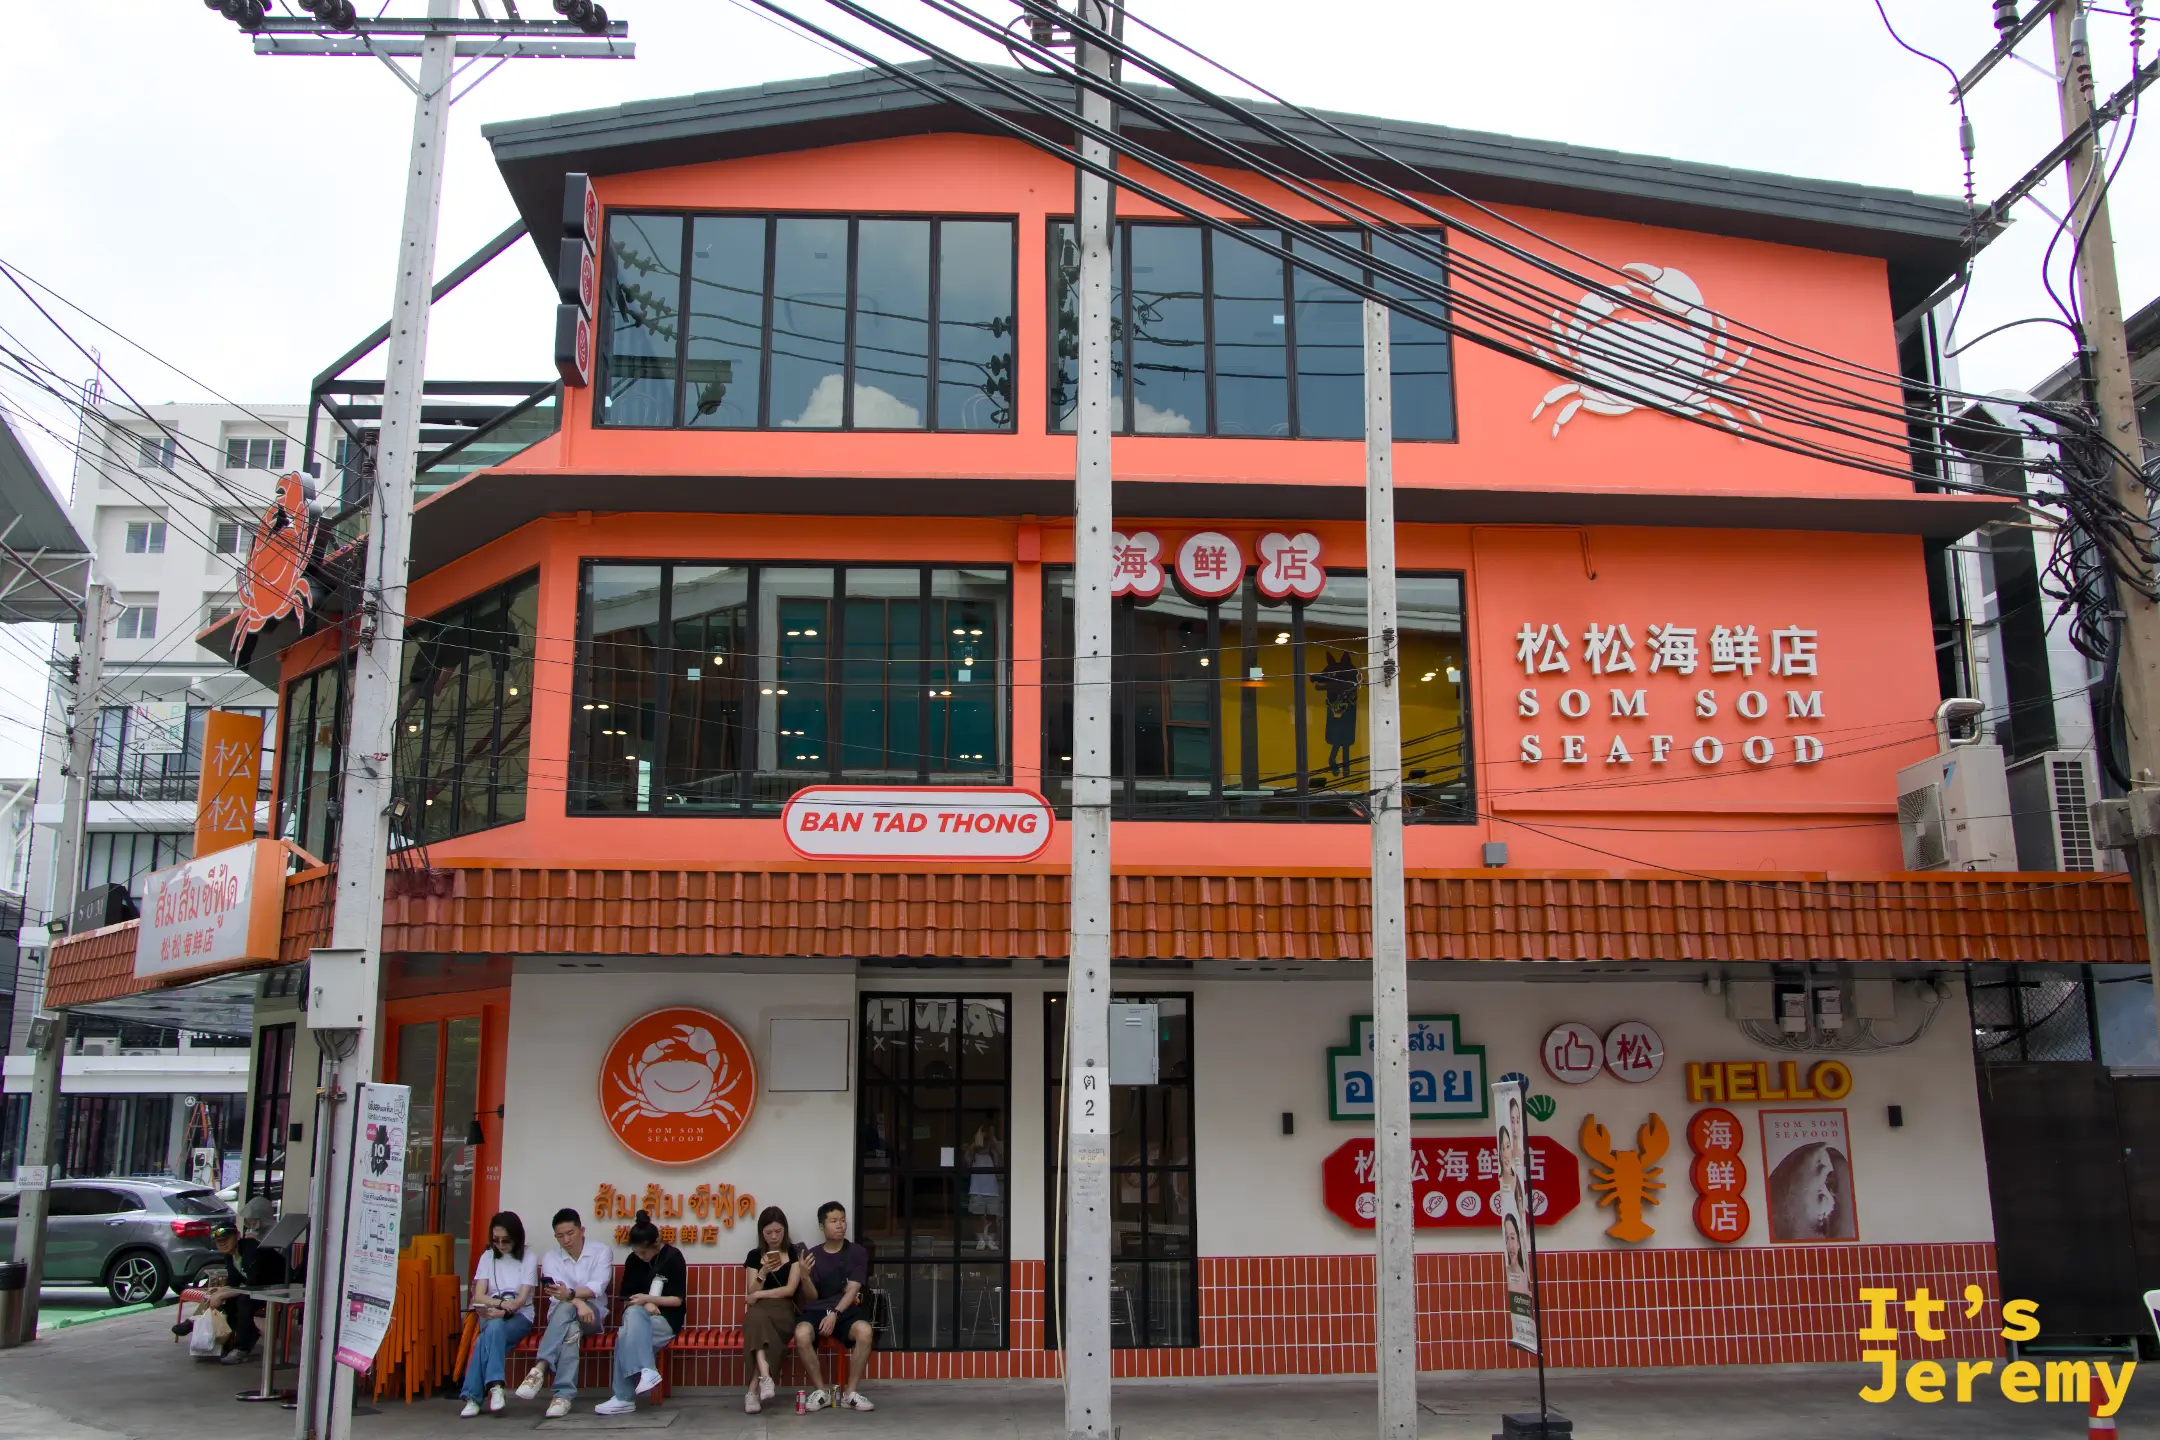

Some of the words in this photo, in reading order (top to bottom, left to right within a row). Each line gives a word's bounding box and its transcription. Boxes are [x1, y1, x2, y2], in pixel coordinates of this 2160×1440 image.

[1112, 544, 1308, 581] 海鲜店
[1516, 622, 1818, 676] 松松海鲜店
[1518, 688, 1649, 718] SOM
[1696, 689, 1825, 719] SOM
[1519, 734, 1825, 765] SEAFOOD
[207, 738, 253, 833] 松松
[800, 812, 864, 832] BAN
[873, 812, 928, 833] TAD
[937, 813, 1038, 834] THONG
[1616, 1033, 1653, 1071] 松
[1686, 1060, 1853, 1104] HELLO
[1085, 1099, 1095, 1116] 2
[1775, 1130, 1839, 1138] SEAFOOD
[1702, 1119, 1738, 1233] 海鲜店
